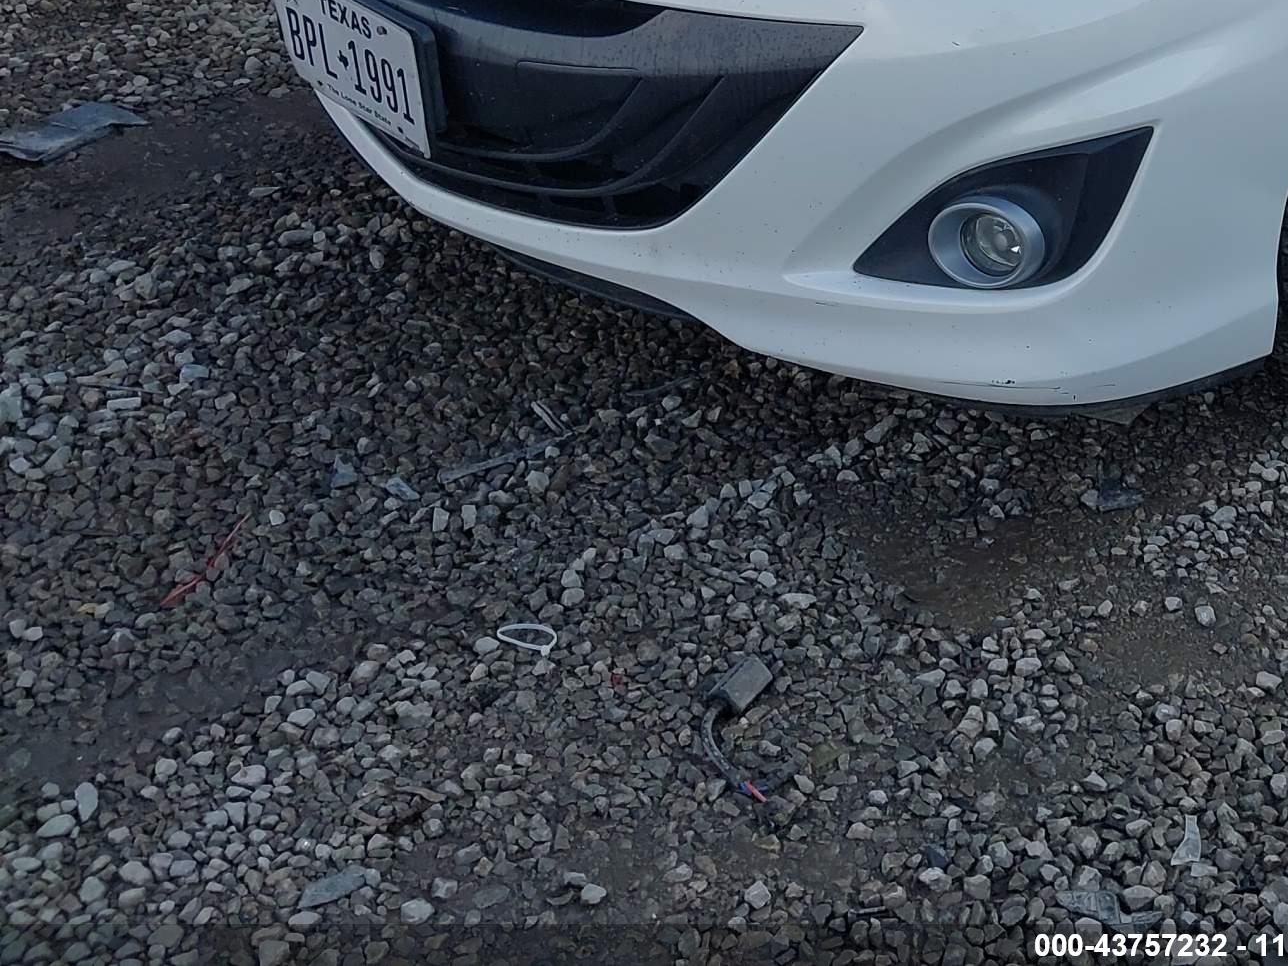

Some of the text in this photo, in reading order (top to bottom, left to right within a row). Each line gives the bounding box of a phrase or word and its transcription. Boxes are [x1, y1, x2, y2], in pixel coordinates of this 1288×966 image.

[286, 7, 415, 125] BPL 1991
[340, 91, 357, 107] Lone
